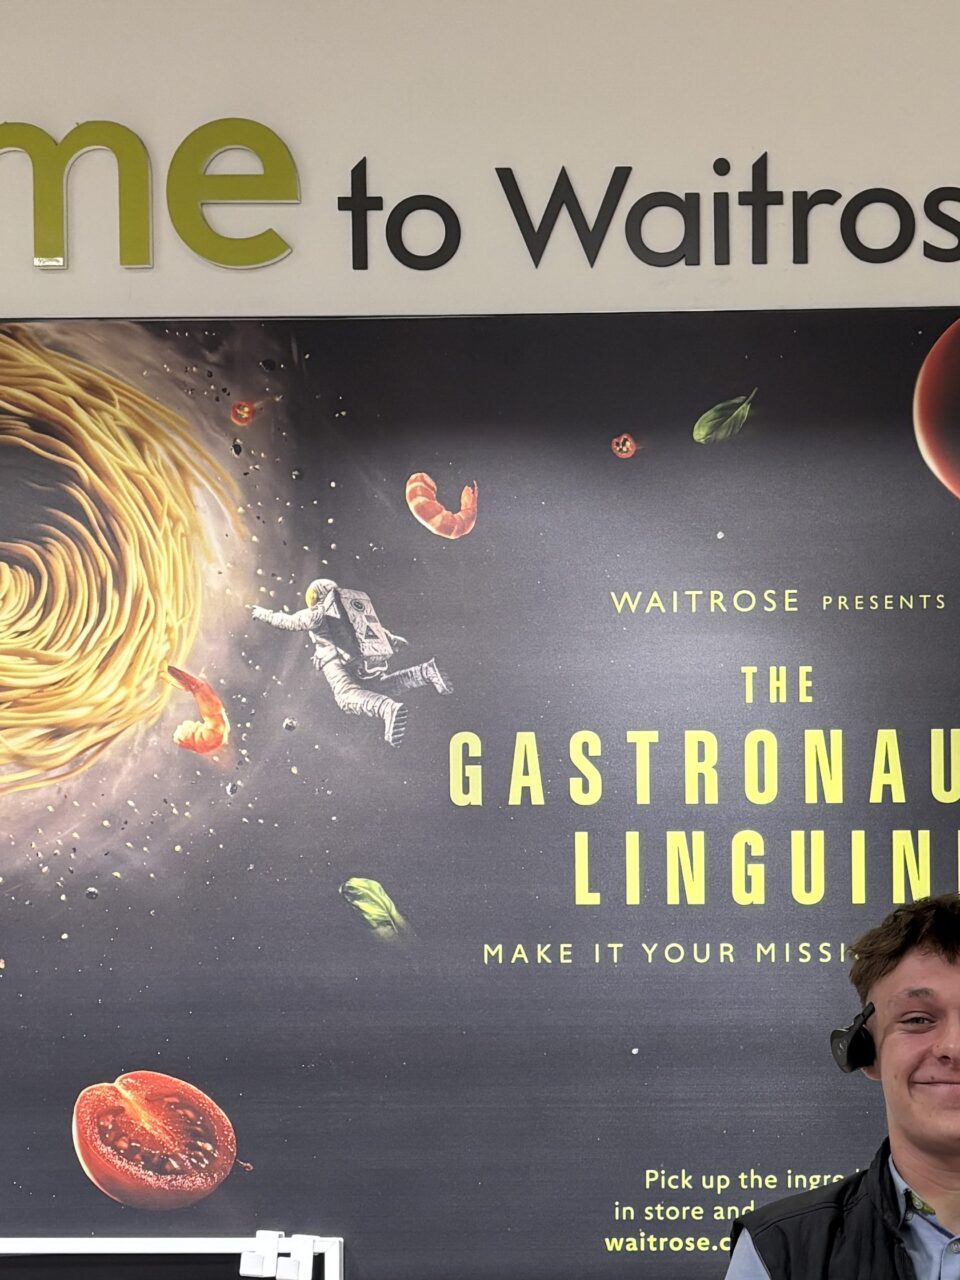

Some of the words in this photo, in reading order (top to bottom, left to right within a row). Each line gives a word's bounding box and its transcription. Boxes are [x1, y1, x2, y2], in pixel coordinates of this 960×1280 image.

[337, 156, 462, 271] to
[611, 589, 798, 614] WAITROSE
[822, 594, 946, 610] PRESENTS
[741, 666, 814, 704] THE
[483, 942, 574, 964] MAKE
[595, 942, 623, 964] IT
[641, 942, 735, 964] YOUR
[756, 942, 860, 963] MISSI
[645, 1169, 693, 1189] Pick
[701, 1174, 730, 1195] up
[739, 1168, 778, 1189] the
[614, 1201, 635, 1220] in
[644, 1203, 704, 1221] store
[604, 1232, 731, 1251] waitrose.c
